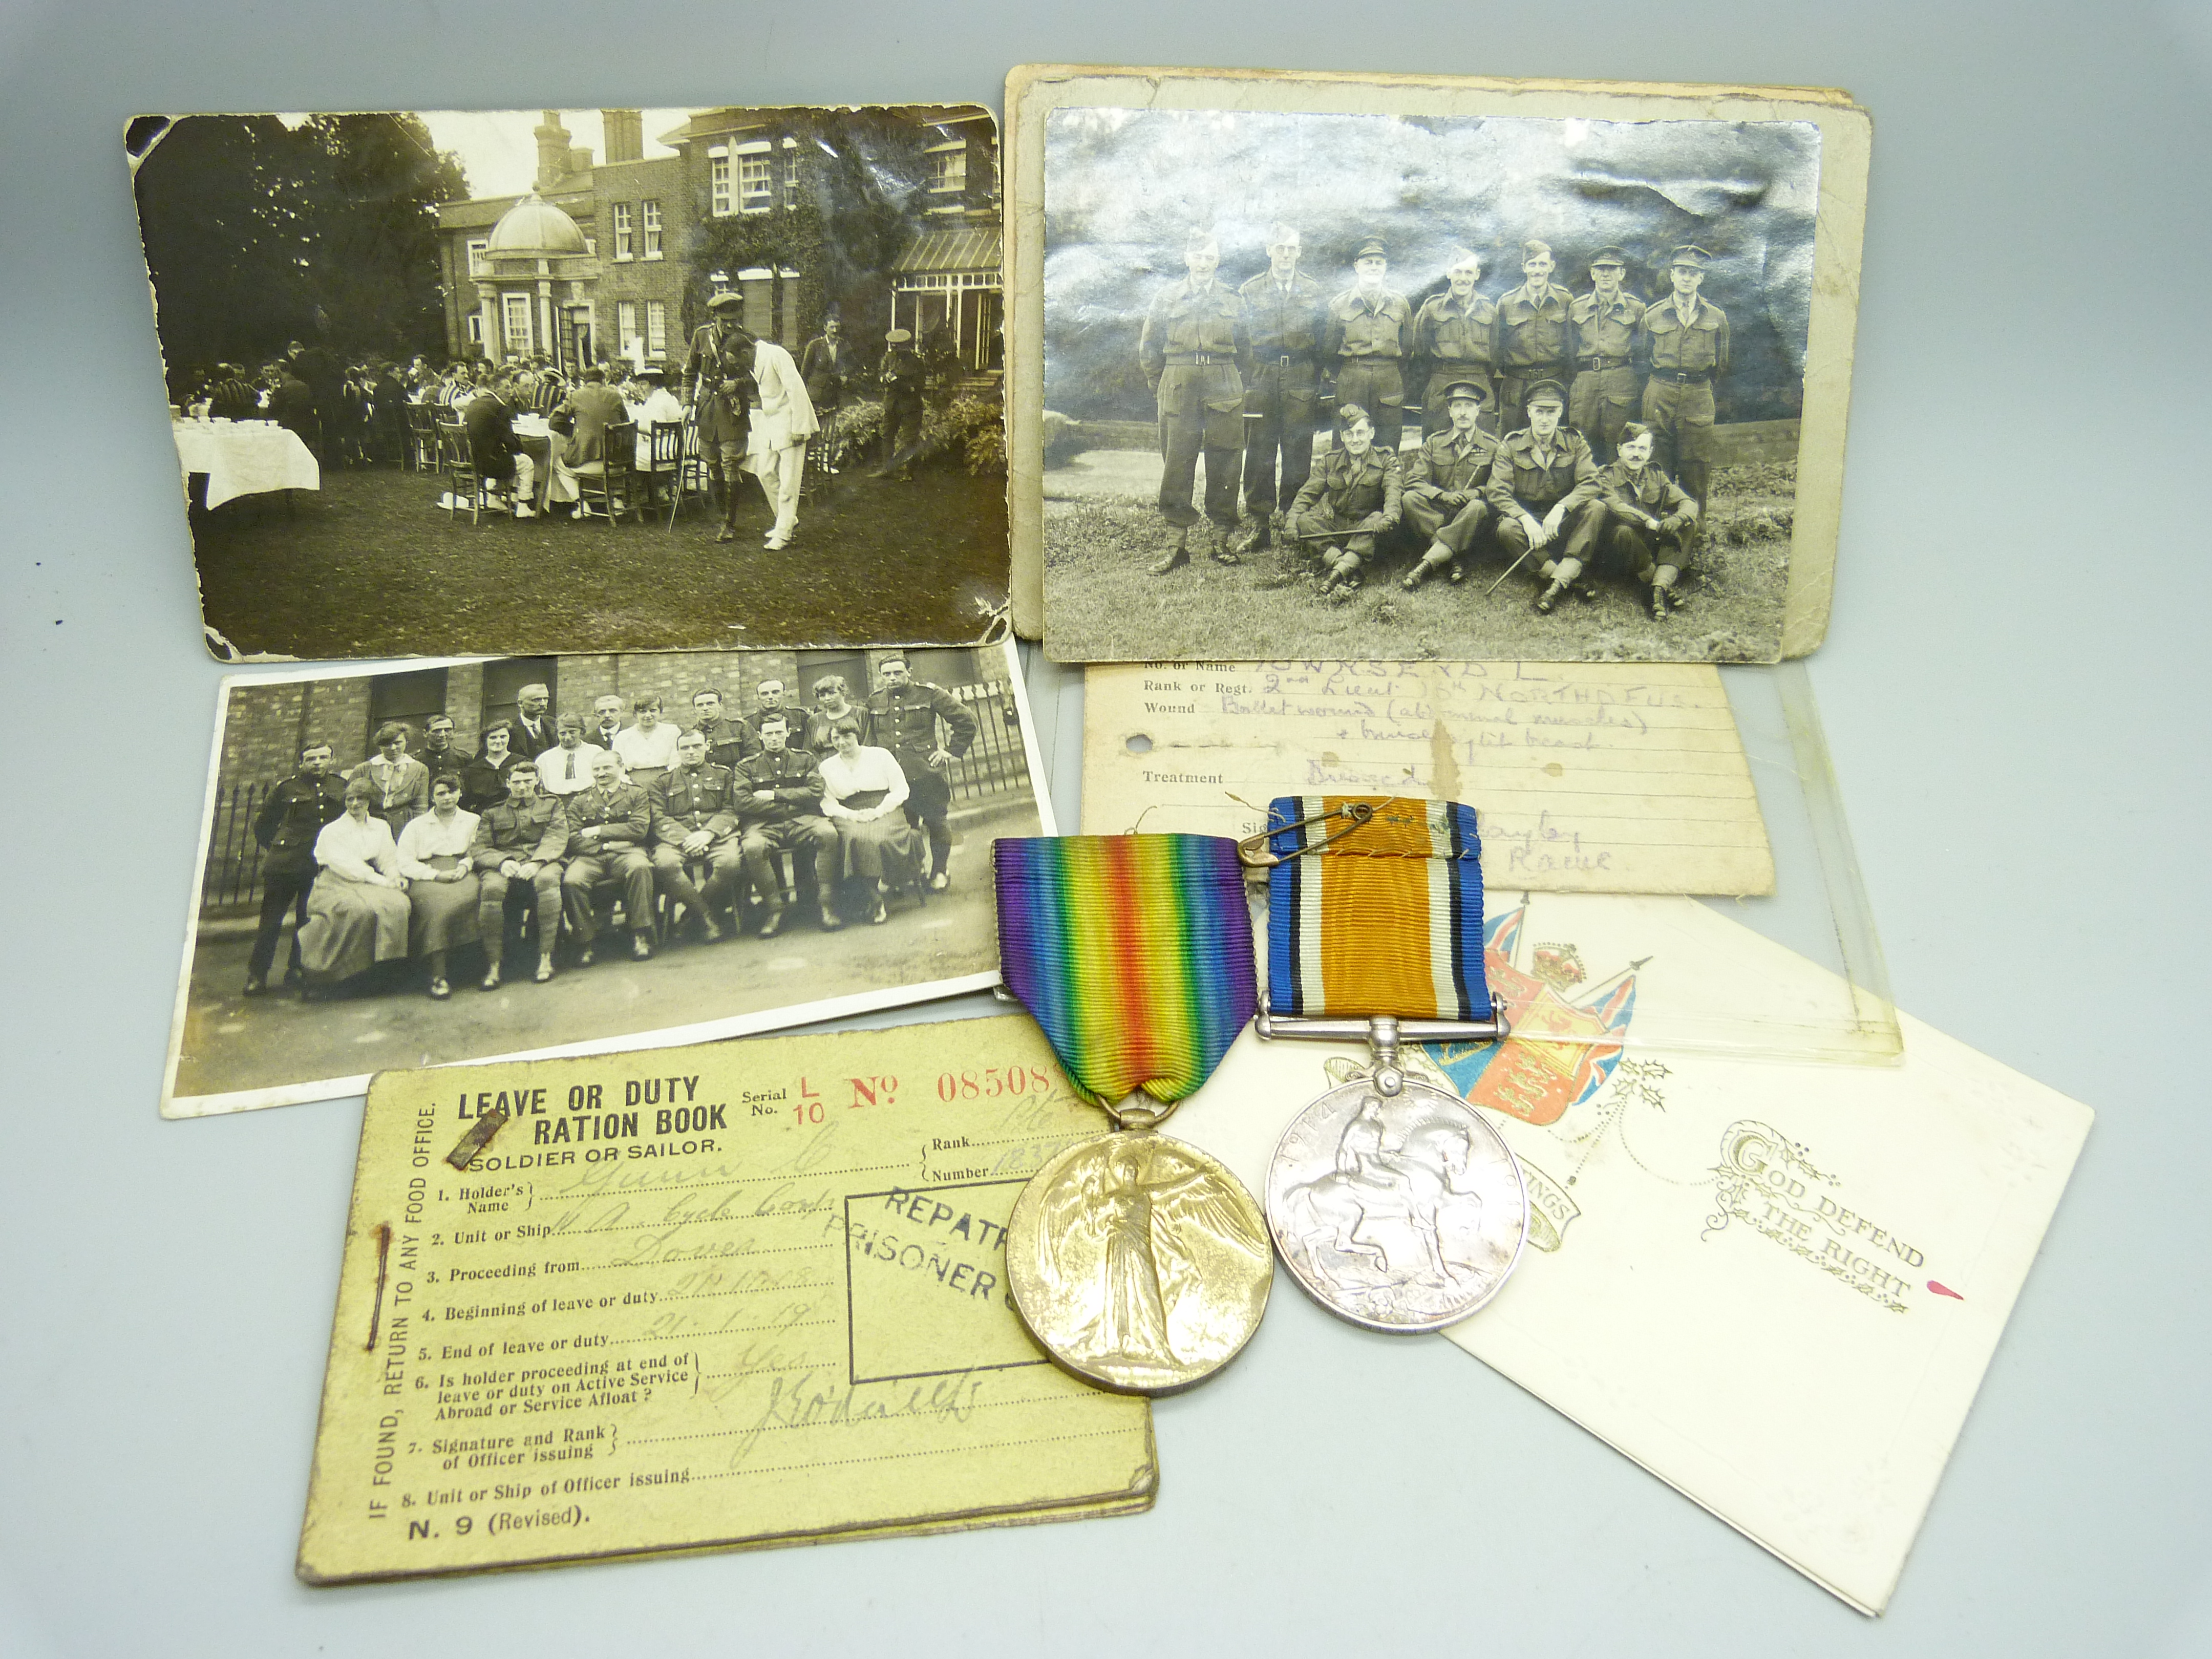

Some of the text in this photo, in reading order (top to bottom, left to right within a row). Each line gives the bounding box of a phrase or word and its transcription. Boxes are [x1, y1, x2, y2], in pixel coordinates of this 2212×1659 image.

[1196, 661, 1237, 672] Name
[1144, 679, 1252, 696] Rank or Regt.
[1144, 701, 1196, 714] Wound
[1143, 770, 1224, 785] Treatment
[741, 1088, 788, 1103] Serial
[800, 1076, 820, 1098] L
[937, 1062, 1064, 1103] 08508
[458, 1075, 700, 1119] LEAVE OR DUTY
[751, 1103, 778, 1117] No.
[534, 1102, 728, 1145] RATION BOOK
[792, 1101, 825, 1125] 10
[469, 1138, 722, 1173] SOLDIER OR SAILOR.
[932, 1136, 971, 1151] Rank
[931, 1166, 989, 1182] Number
[438, 1183, 524, 1202] 1. Holder's
[466, 1202, 509, 1215] Name
[431, 1221, 551, 1247] 2. Unit or Ship
[1814, 1195, 1924, 1268] DEFEND
[1762, 1201, 1911, 1298] THE RIGHT
[426, 1260, 580, 1284] 3. Proceeding from
[369, 1101, 437, 1520] IF FOUND, RETURN TO ANY FOOD OFFICE.
[421, 1290, 659, 1322] 4. Beginning of leave or duty
[417, 1333, 609, 1361] 5. End of leave or duty
[414, 1351, 689, 1390] 6. Is holder proceeding at end of
[436, 1369, 689, 1405] leave or duty on Active Service
[434, 1402, 493, 1421] Abroad
[498, 1401, 516, 1416] or
[522, 1396, 583, 1415] Service
[588, 1389, 637, 1407] Afloat
[408, 1424, 607, 1455] 7. Signature and Rank
[442, 1443, 594, 1472] of Officer issuing
[401, 1466, 691, 1509] 8. Unit or Ship of Officer issuing
[408, 1503, 592, 1542] N. 9 (Revised).
